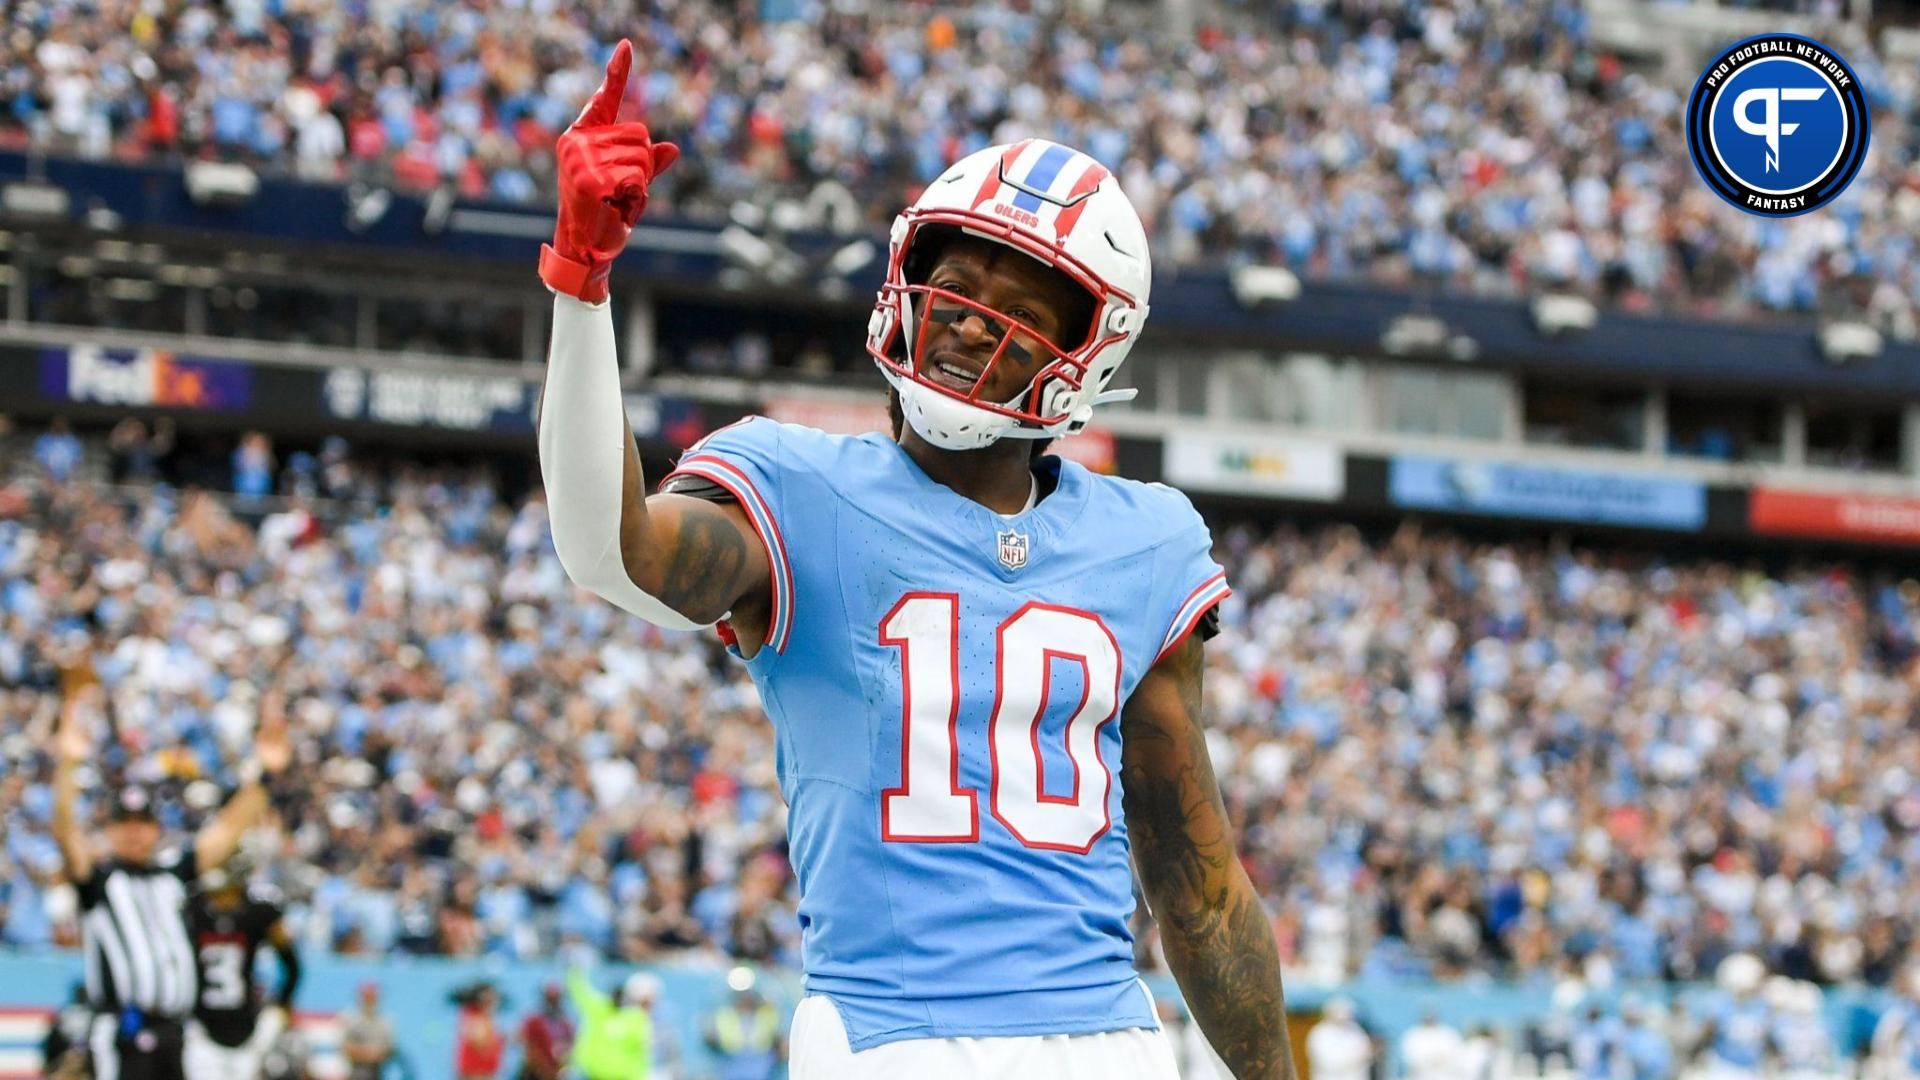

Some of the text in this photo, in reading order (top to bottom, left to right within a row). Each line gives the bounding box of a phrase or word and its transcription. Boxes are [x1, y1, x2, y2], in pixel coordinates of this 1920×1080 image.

[994, 203, 1040, 229] OILERS
[1002, 546, 1024, 563] NFL
[878, 591, 1122, 856] 10
[199, 943, 247, 1010] 3
